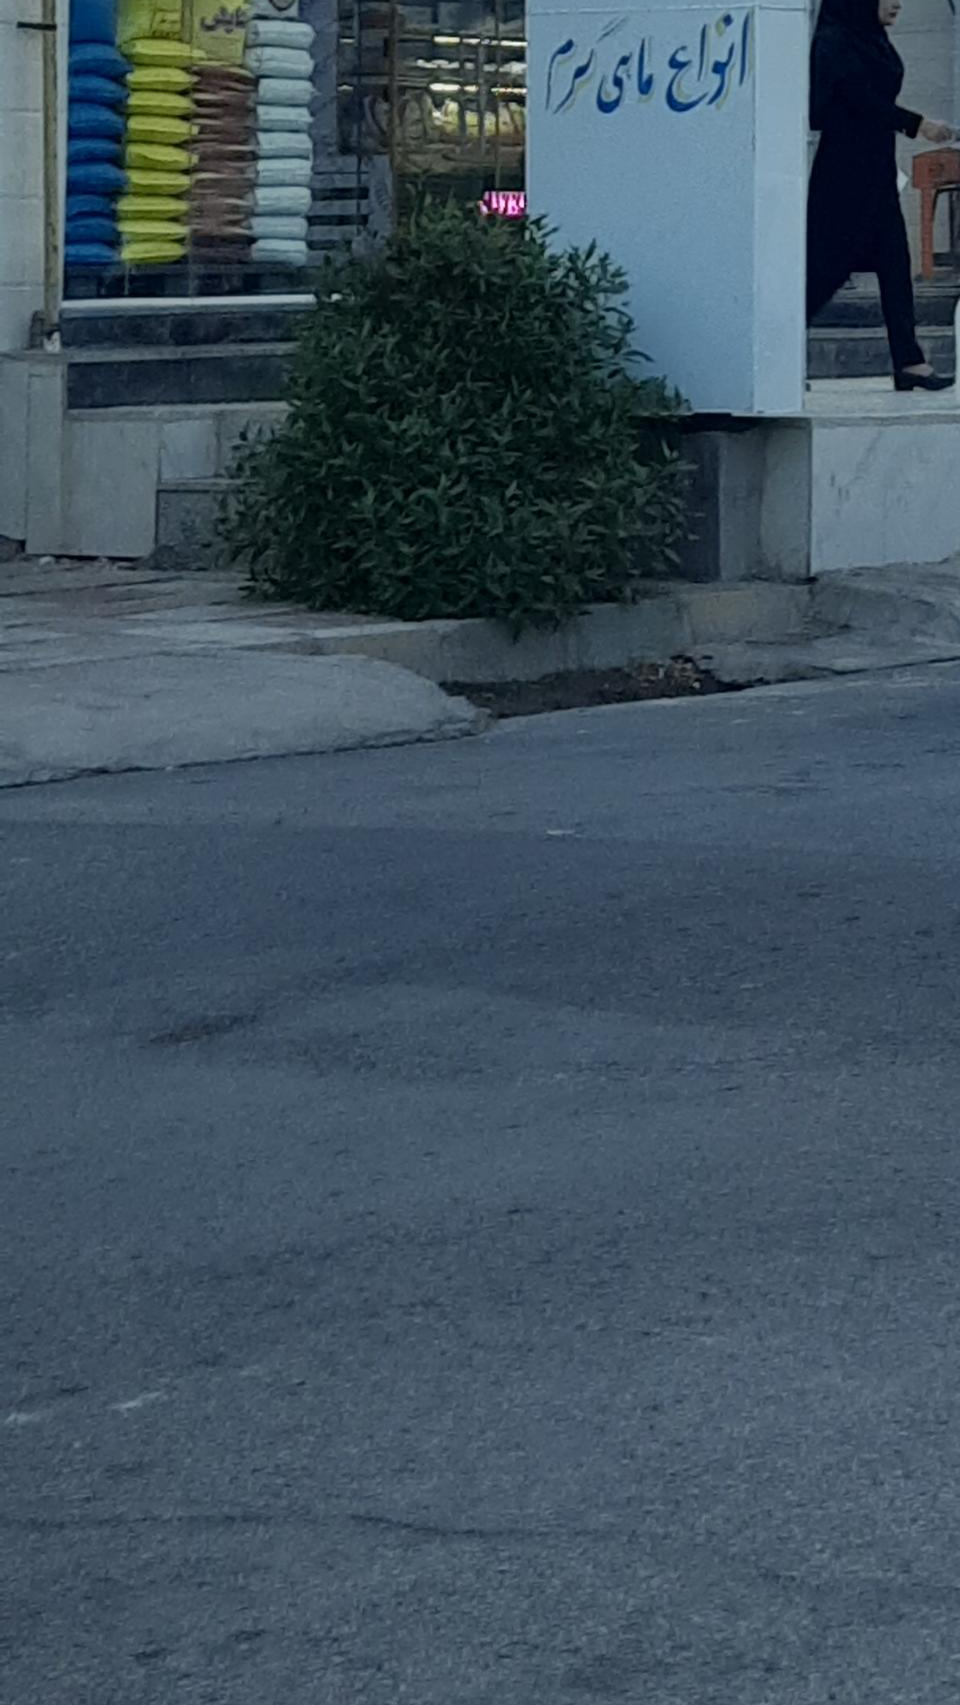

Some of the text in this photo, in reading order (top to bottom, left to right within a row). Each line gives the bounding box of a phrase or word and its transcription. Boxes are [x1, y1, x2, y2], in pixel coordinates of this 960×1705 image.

[546, 11, 756, 114] انواع ماهی گرم
